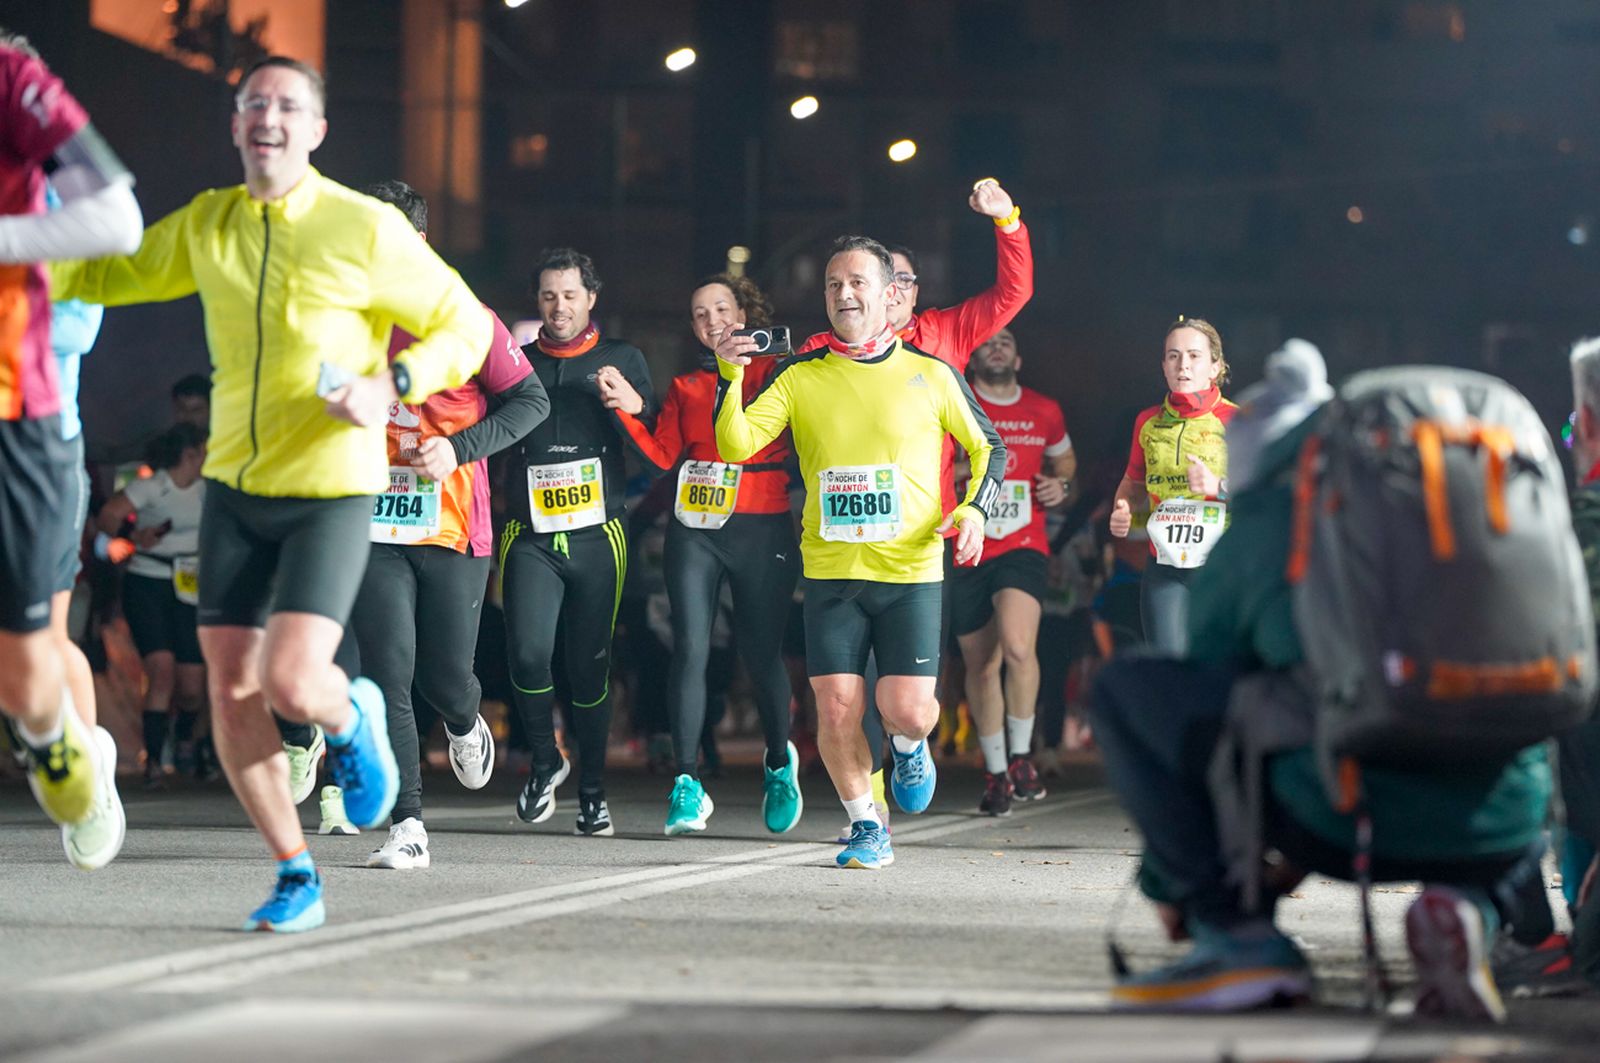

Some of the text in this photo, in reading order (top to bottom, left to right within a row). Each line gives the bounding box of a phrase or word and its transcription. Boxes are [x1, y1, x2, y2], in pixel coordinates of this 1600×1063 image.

[399, 475, 409, 483] DE
[544, 471, 565, 479] NOCHE
[566, 470, 574, 478] DE
[835, 474, 868, 483] NOCHE DE
[536, 480, 551, 488] SAN
[827, 484, 841, 492] SAN
[543, 484, 591, 509] 8669
[689, 485, 726, 507] 8670
[828, 492, 891, 517] 12680
[989, 502, 1019, 518] 523
[1165, 506, 1197, 514] NOCHE DE
[1156, 514, 1171, 522] SAN
[1165, 524, 1204, 544] 1779
